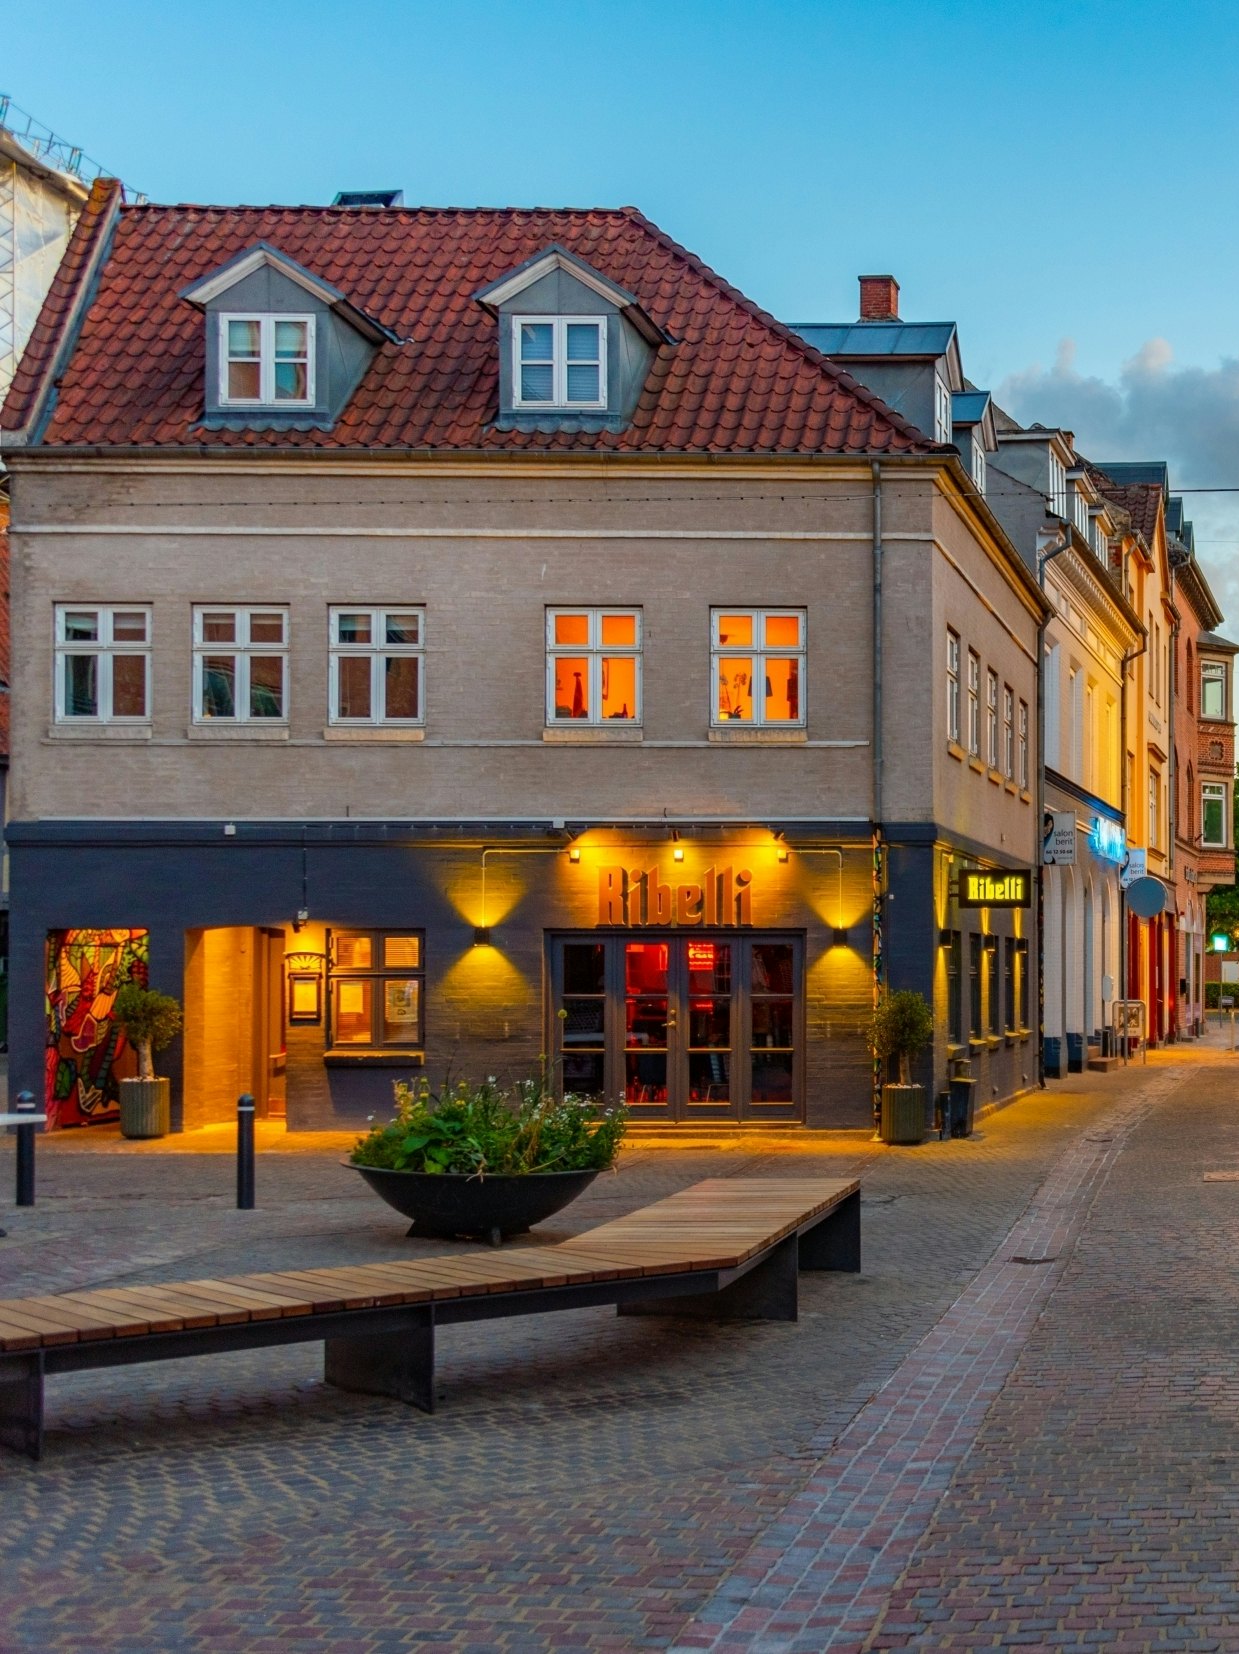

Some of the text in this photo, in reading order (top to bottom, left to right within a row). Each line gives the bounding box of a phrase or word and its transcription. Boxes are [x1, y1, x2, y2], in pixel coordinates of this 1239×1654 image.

[1053, 829, 1073, 837] salon
[596, 864, 754, 927] Ribelli
[968, 877, 1023, 899] Ribelli
